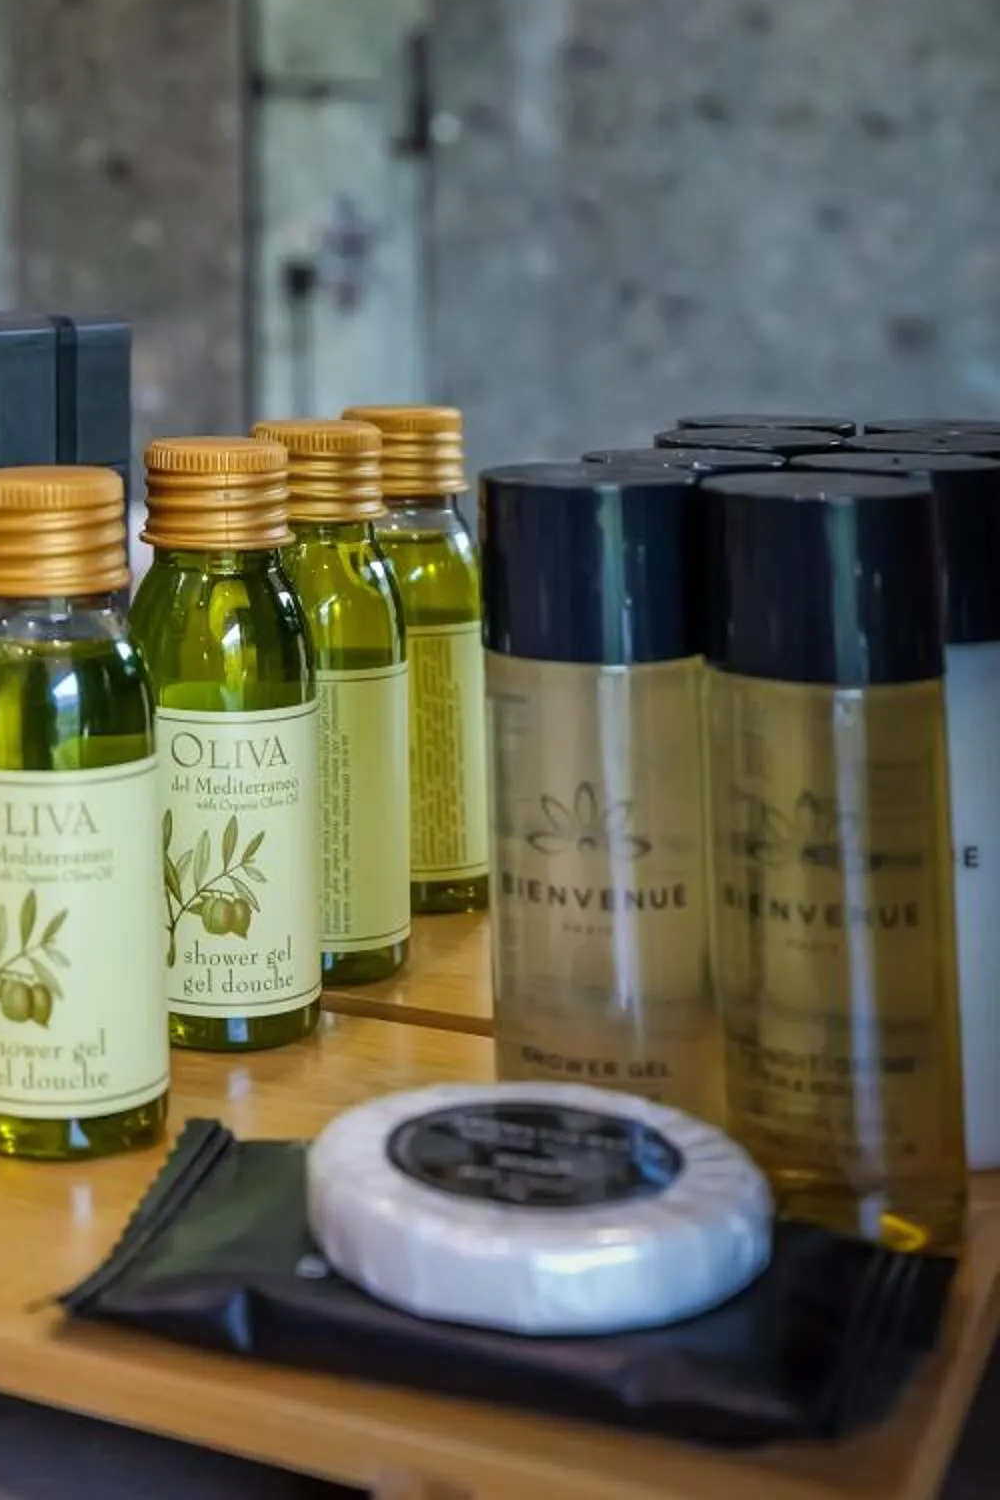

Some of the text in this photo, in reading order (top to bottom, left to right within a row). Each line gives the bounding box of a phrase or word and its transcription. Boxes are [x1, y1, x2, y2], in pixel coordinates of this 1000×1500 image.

[170, 731, 290, 769] OLIVA
[171, 774, 300, 795] del Mediterraneo
[502, 871, 688, 912] BIENVENUE
[183, 934, 292, 969] shower gel
[183, 967, 293, 996] gel douche
[73, 1027, 106, 1064] gel
[20, 1060, 110, 1090] douche
